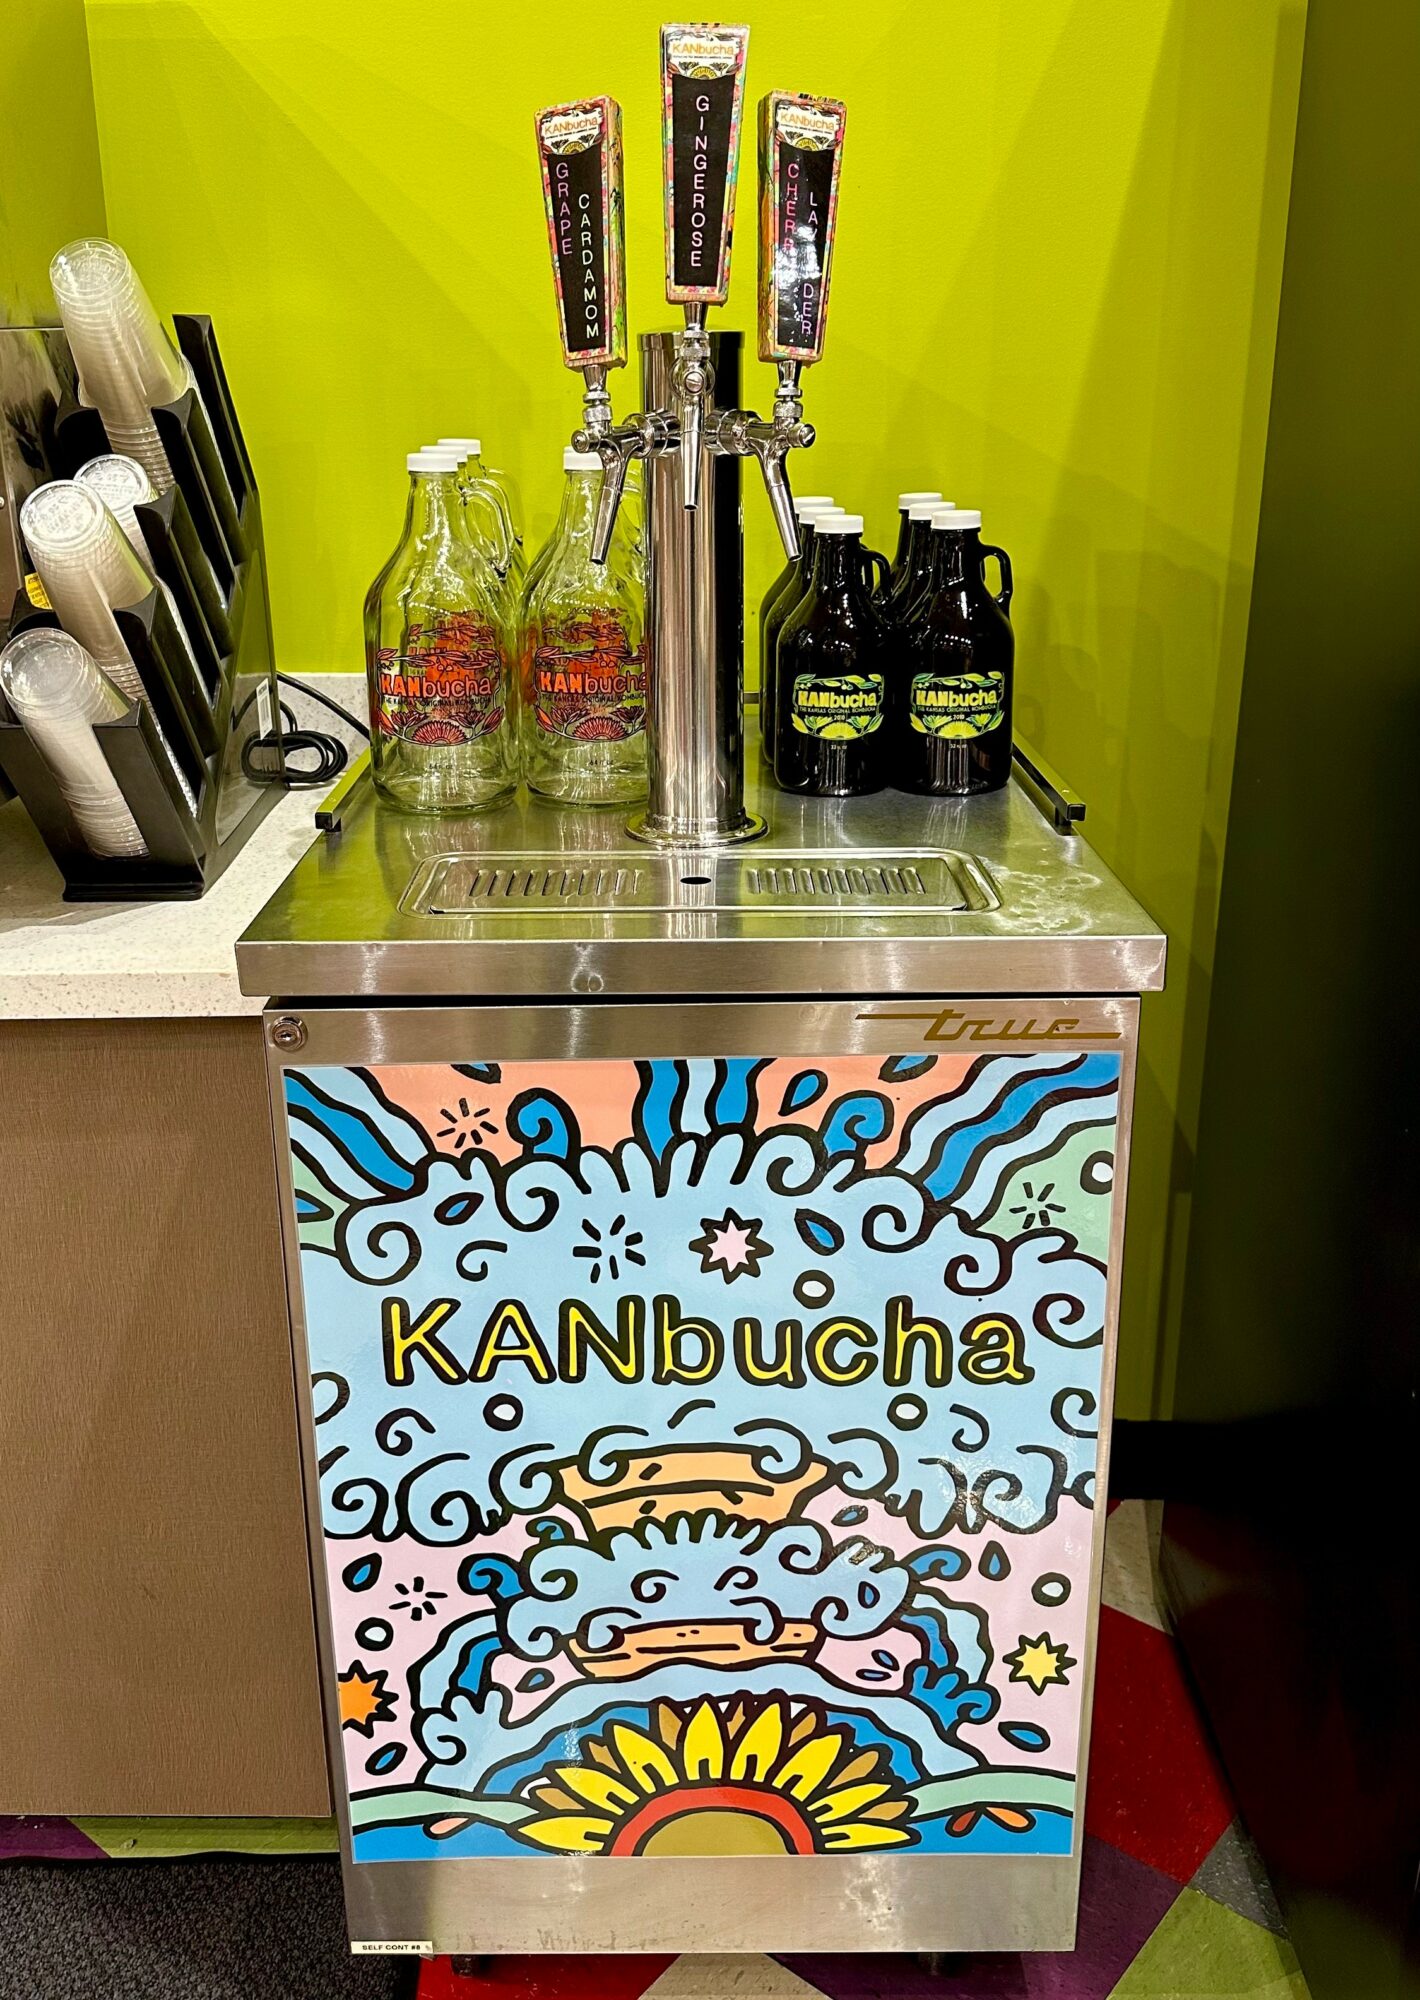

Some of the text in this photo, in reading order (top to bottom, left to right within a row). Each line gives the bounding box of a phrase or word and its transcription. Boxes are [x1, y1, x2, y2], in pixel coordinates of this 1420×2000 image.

[672, 43, 734, 55] KANbucha
[544, 116, 598, 135] KANbucha
[780, 112, 835, 131] KANbucha
[690, 95, 709, 267] GINGEROSE
[556, 162, 573, 255] GRAPE
[783, 163, 799, 262] CHERR
[578, 194, 599, 339] CARDAMOM
[801, 191, 818, 334] LADER
[380, 674, 492, 699] KANbucha
[798, 690, 877, 708] KANbucha
[915, 689, 998, 707] KANbucha
[855, 1009, 1121, 1041] true
[381, 1294, 1036, 1388] KANbucha
